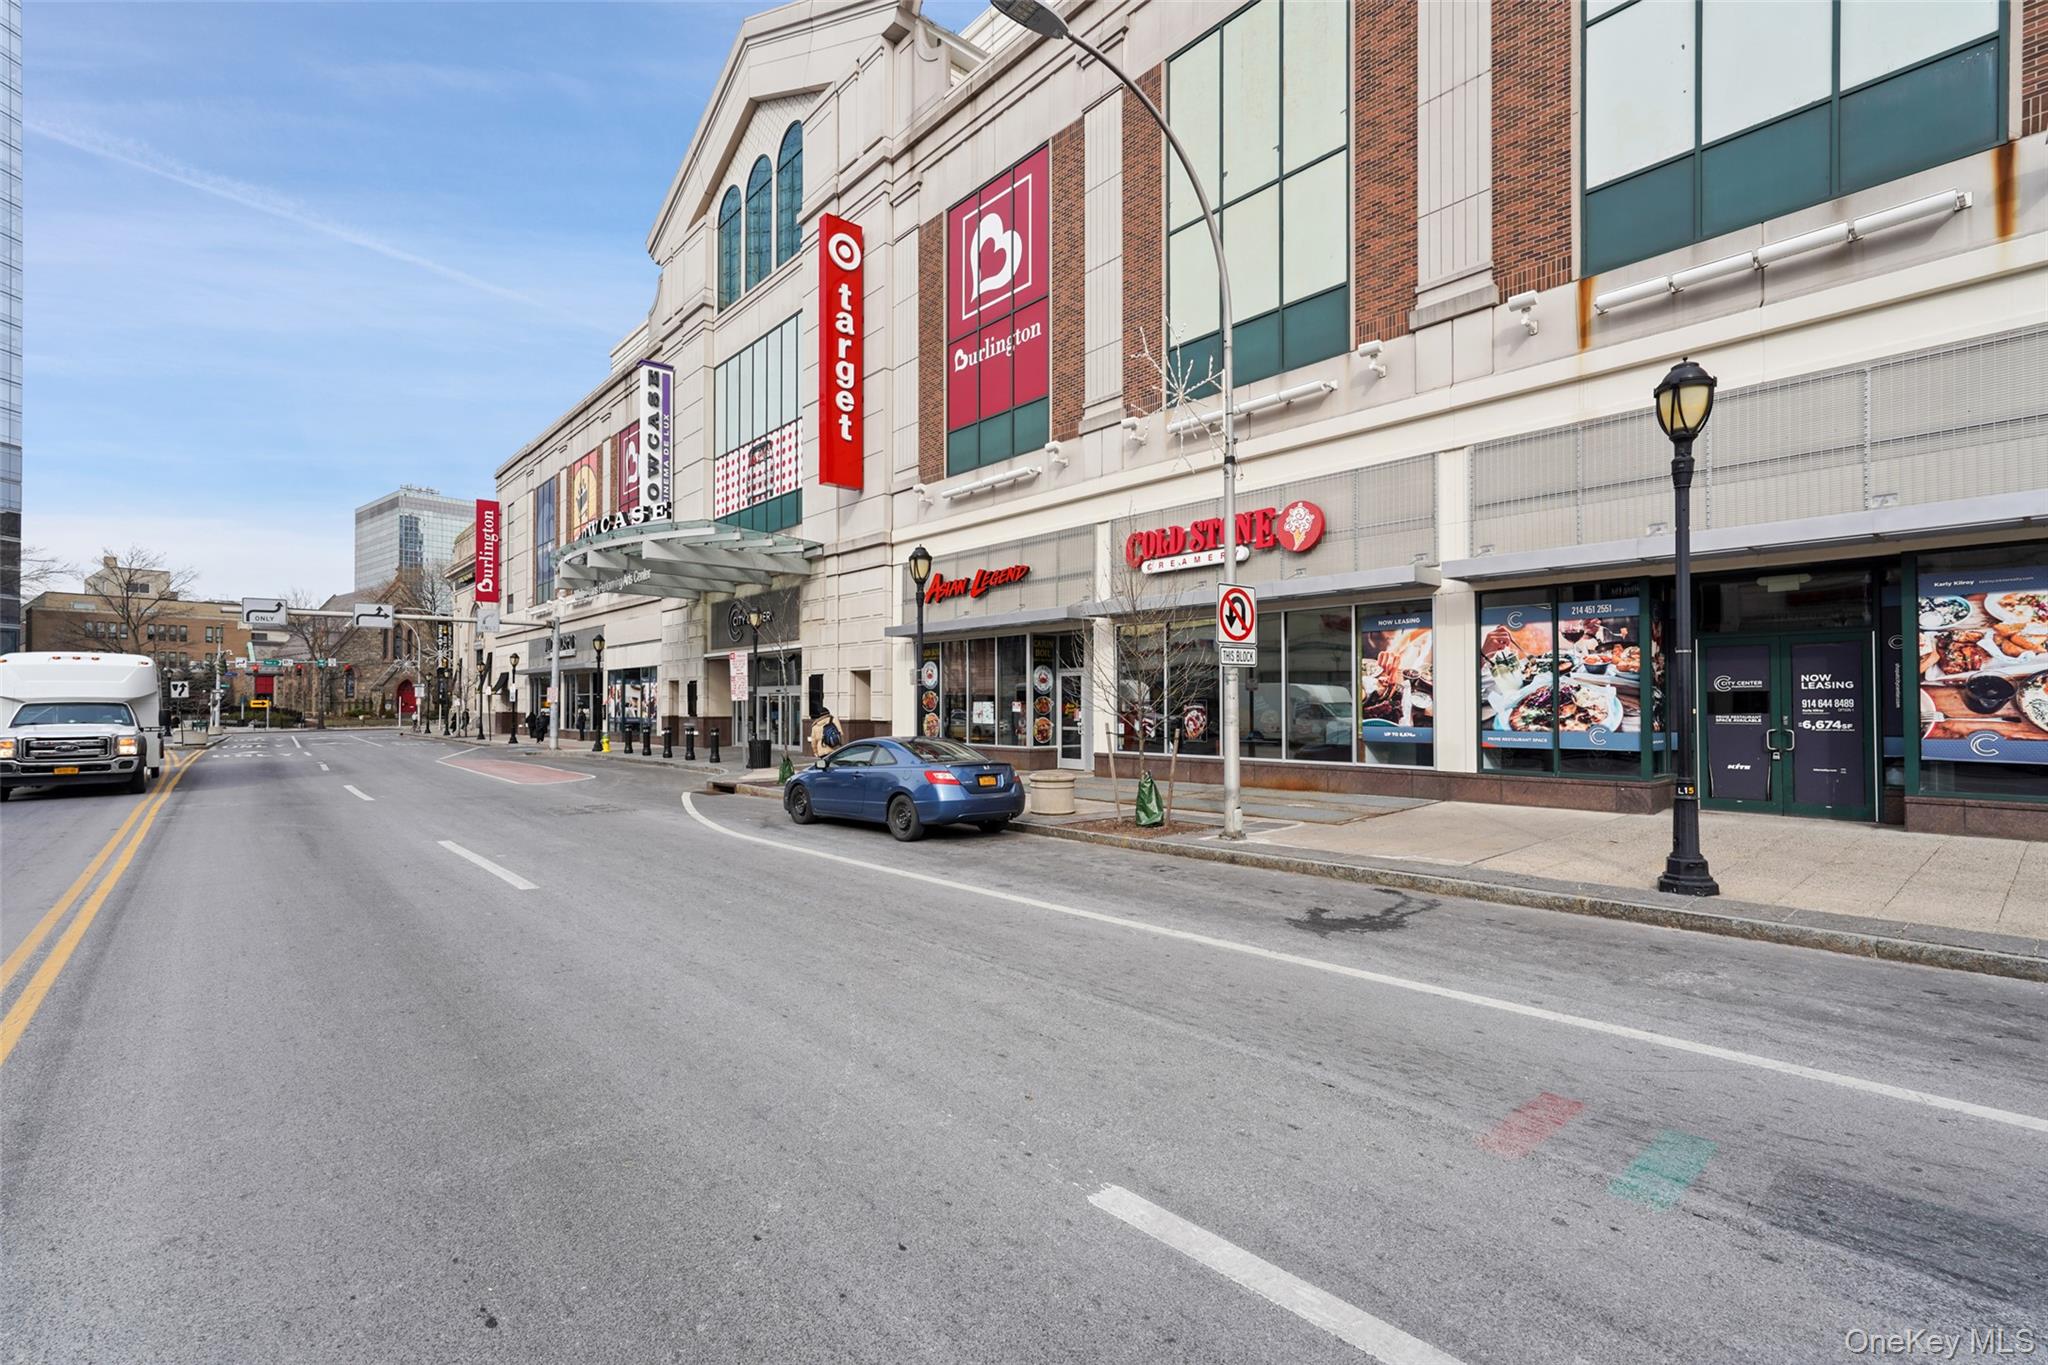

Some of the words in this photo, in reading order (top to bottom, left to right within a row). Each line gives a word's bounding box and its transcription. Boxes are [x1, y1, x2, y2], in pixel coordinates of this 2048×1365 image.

[835, 283, 855, 441] target
[954, 322, 1042, 373] Burlington
[647, 370, 660, 501] OWCASE
[663, 440, 670, 456] DE
[574, 502, 672, 542] OWCASE
[477, 510, 499, 592] Burlington
[1126, 525, 1186, 569] COLD
[623, 573, 633, 587] Arts
[634, 568, 651, 583] Center
[1571, 606, 1583, 615] 214
[1584, 605, 1595, 614] 451
[1597, 604, 1612, 613] 2551
[1223, 650, 1234, 662] THIS
[1236, 650, 1254, 662] BLOCK
[1801, 681, 1854, 689] LEASING
[1802, 699, 1816, 708] 914
[1818, 699, 1832, 708] 644
[1834, 699, 1854, 707] 8489
